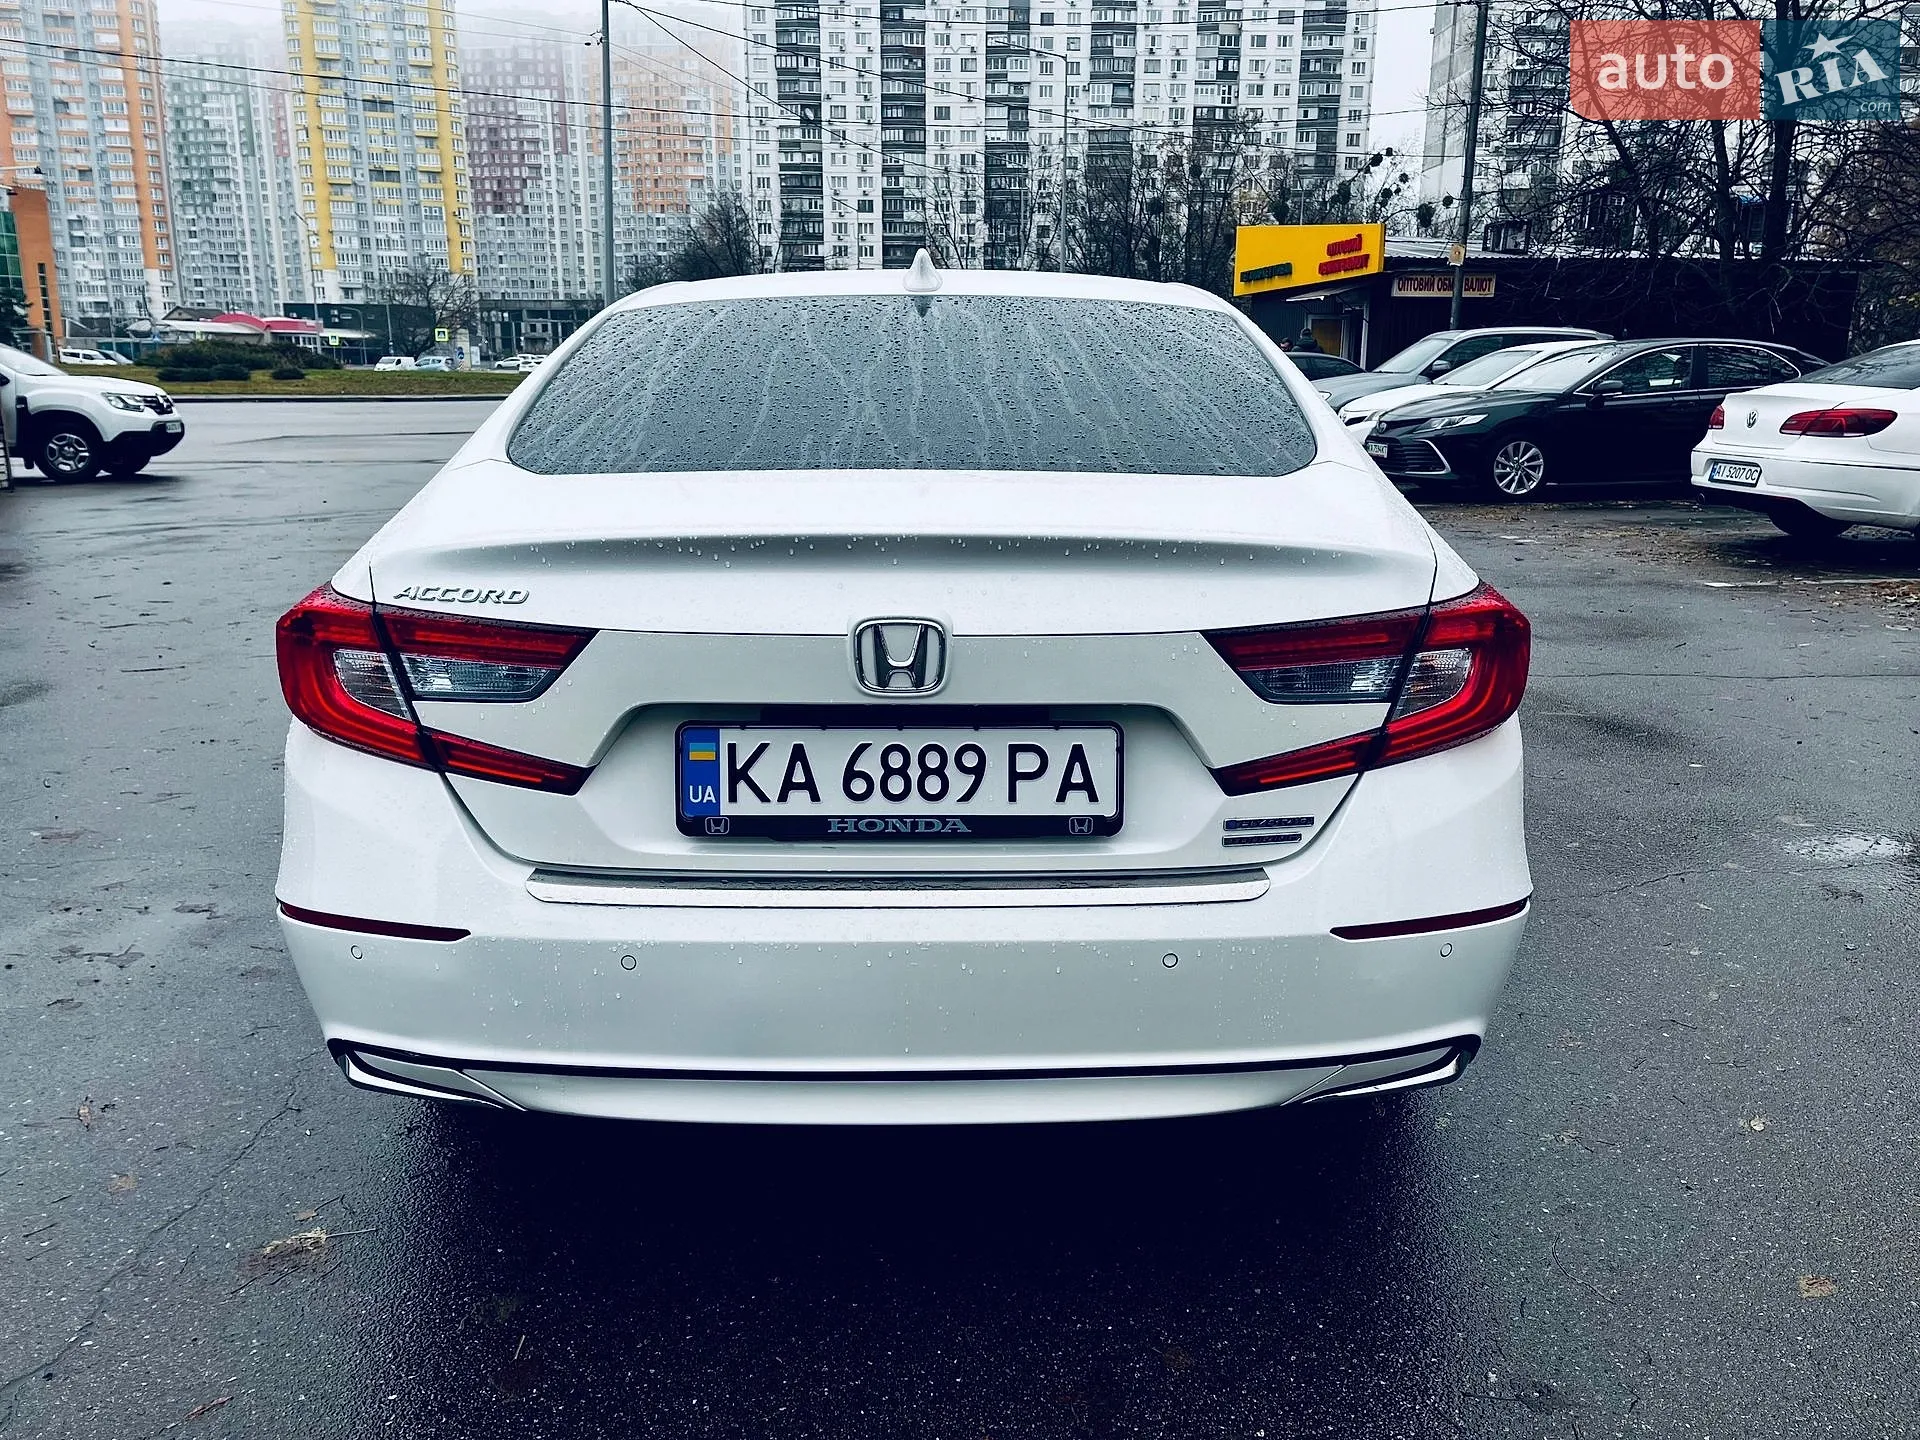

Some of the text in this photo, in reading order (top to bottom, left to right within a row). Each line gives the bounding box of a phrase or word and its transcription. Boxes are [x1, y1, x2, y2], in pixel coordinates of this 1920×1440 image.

[1397, 275, 1493, 293] ОПТОВИЙ ОБМ ВАЛЮТ
[1726, 466, 1746, 480] 5207
[1745, 469, 1758, 481] OC
[393, 587, 530, 605] ACCORD
[727, 742, 1100, 803] KA 6889 PA
[689, 785, 716, 804] UA
[827, 818, 972, 834] HONDA
